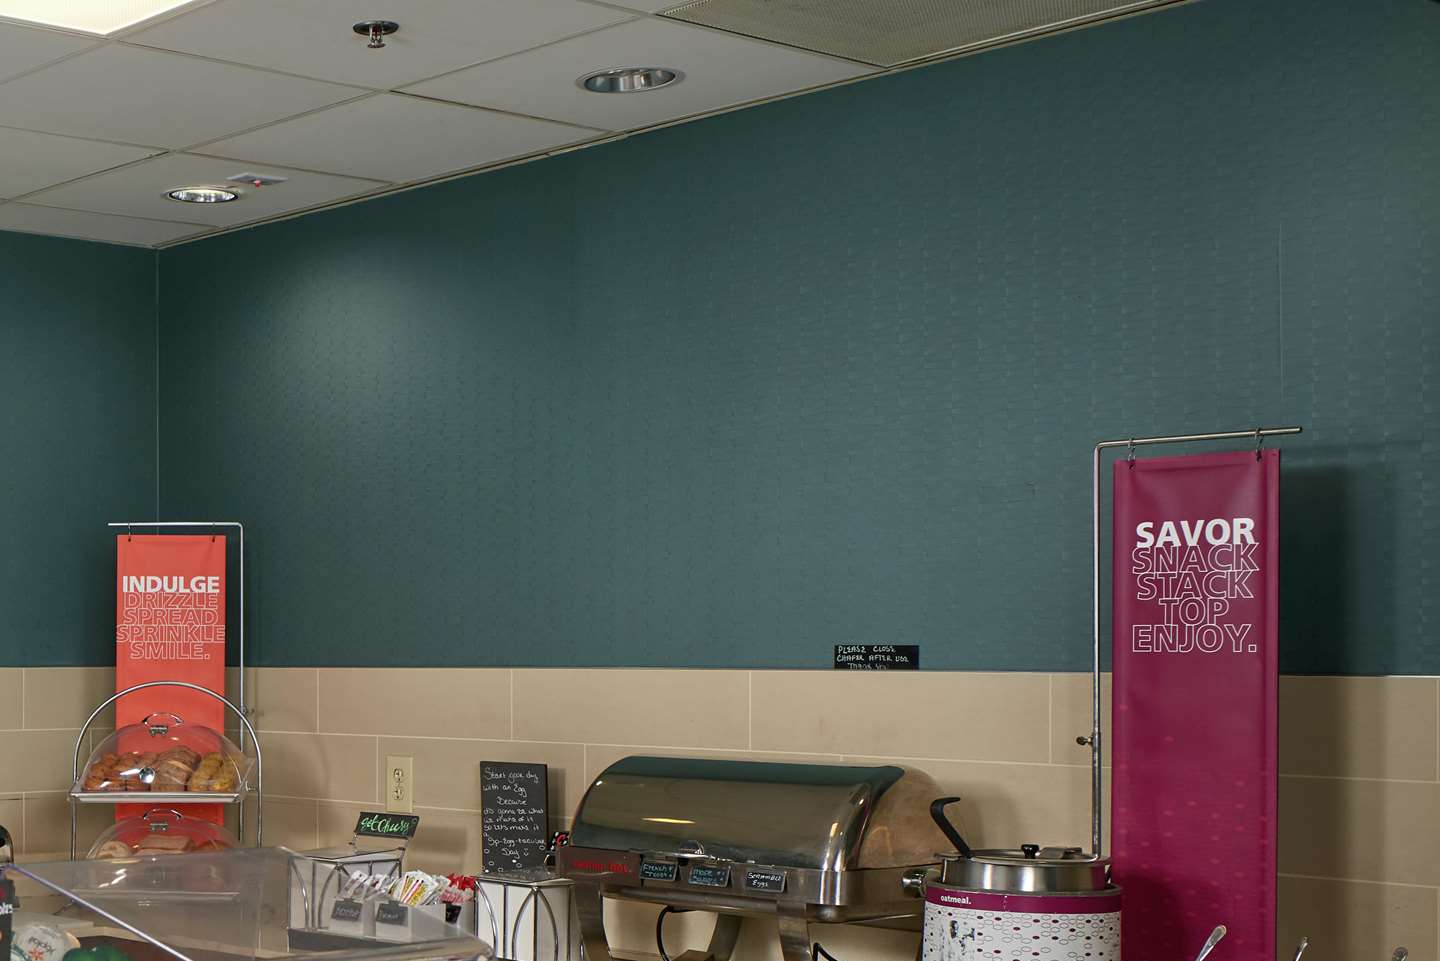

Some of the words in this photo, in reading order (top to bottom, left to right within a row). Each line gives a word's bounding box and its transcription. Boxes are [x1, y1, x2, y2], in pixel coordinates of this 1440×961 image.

[1135, 517, 1256, 549] SAVOR
[1131, 542, 1260, 575] SNACK
[122, 575, 220, 593] INDULGE
[1136, 569, 1255, 601] STACK
[123, 591, 219, 610] DRIZZLE
[123, 607, 219, 626] SPREAD
[1158, 597, 1230, 626] TOP
[115, 623, 225, 643] SPRINKLE
[1132, 623, 1257, 653] ENJOY.
[129, 641, 211, 660] SMILE.
[868, 654, 892, 662] AFTER
[940, 894, 972, 905] oatmeal.
